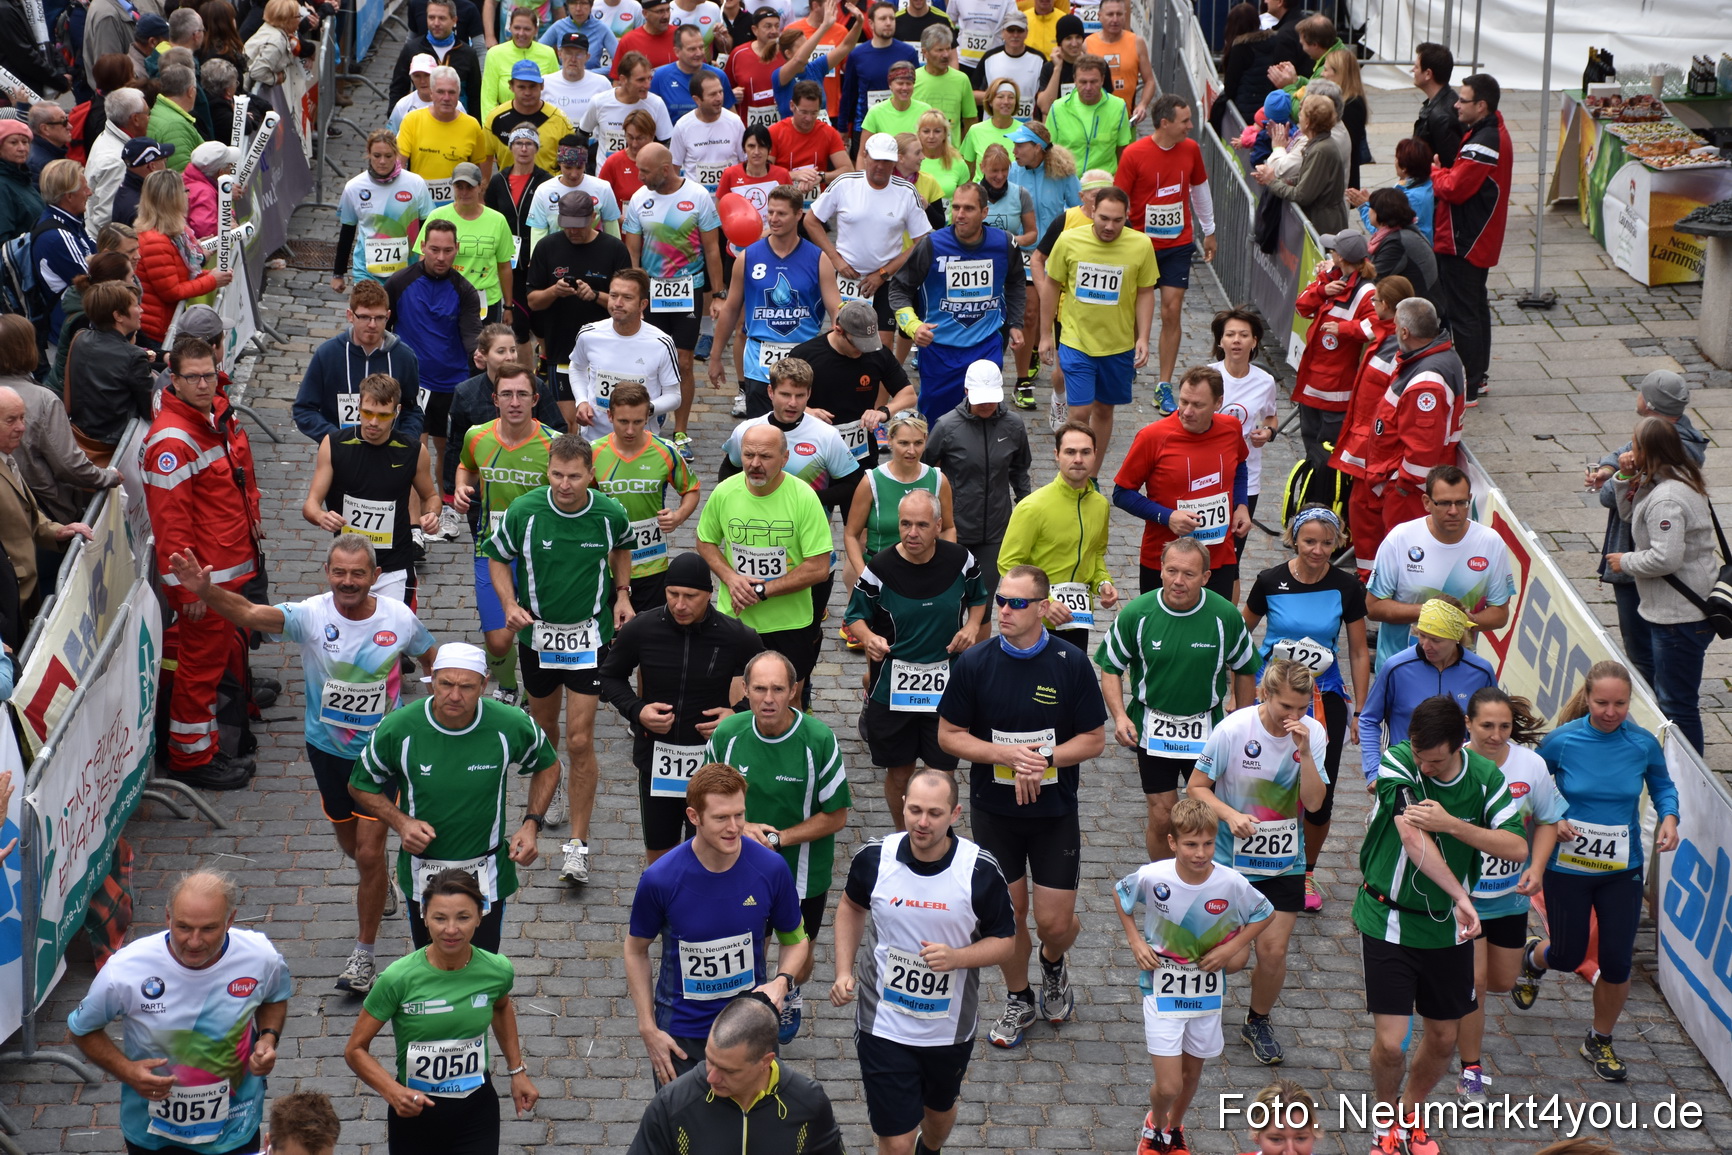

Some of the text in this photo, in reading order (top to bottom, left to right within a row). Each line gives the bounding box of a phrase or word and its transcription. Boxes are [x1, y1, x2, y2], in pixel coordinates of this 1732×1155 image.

[967, 38, 988, 50] 532
[232, 102, 244, 148] Laufsport
[750, 113, 778, 128] 2494
[251, 131, 270, 160] BMW
[693, 139, 731, 147] www.hasit.de
[221, 199, 232, 230] BMW
[1149, 211, 1182, 226] 3333
[374, 248, 402, 263] 274
[751, 263, 768, 280] 8
[1094, 267, 1116, 275] Neumarkt
[951, 270, 989, 288] 2019
[1080, 272, 1118, 291] 2110
[654, 282, 690, 298] 2624
[1088, 291, 1106, 299] Robin
[940, 298, 1000, 312] FIBALON
[753, 306, 811, 319] FIBALON
[866, 324, 876, 335] 85
[479, 466, 544, 487] BOCK
[1198, 477, 1213, 486] DEHN
[598, 479, 661, 496] BOCK
[344, 498, 388, 511] PARTL Neumarkt
[1178, 498, 1221, 510] PARTL Neumarkt
[350, 509, 386, 531] 277
[1193, 529, 1221, 540] Michael
[732, 546, 748, 556] PARTL
[736, 555, 783, 576] 2153
[1406, 563, 1425, 571] PARTL
[557, 623, 585, 632] Neumarkt
[542, 630, 591, 651] 2664
[555, 654, 580, 663] Rainer
[893, 663, 913, 672] PARTL
[325, 681, 347, 692] PARTL
[897, 672, 945, 692] 2226
[328, 691, 382, 713] 2227
[909, 695, 931, 705] Frank
[343, 714, 362, 724] Karl
[1153, 718, 1203, 740] 2530
[993, 735, 1045, 745] PARTL Neumarkt
[1163, 741, 1190, 752] Hubert
[655, 745, 676, 756] PARTL
[467, 764, 490, 772] africon
[658, 755, 704, 778] 312
[1242, 759, 1262, 768] PARTL
[1587, 828, 1620, 838] Neumarkt
[1240, 833, 1293, 856] 2262
[1574, 836, 1617, 859] 244
[1249, 858, 1283, 869] Melanie
[1571, 857, 1614, 870] Brunhilde
[905, 899, 950, 911] KLEBL
[680, 941, 741, 955] PARTL Neumarkt
[688, 948, 746, 978] 2511
[888, 952, 911, 966] PARTL
[231, 981, 256, 993] Hervis
[695, 976, 744, 992] Alexander
[890, 965, 950, 996] 2694
[1160, 971, 1218, 995] 2119
[140, 1002, 167, 1011] PARTL
[897, 995, 936, 1011] Andreas
[1174, 999, 1203, 1009] Moritz
[410, 1041, 474, 1054] PARTL Neumarkt
[415, 1051, 479, 1081] 2050
[177, 1089, 217, 1100] Neumarkt
[430, 1083, 461, 1093] Maria
[156, 1096, 223, 1124] 3057
